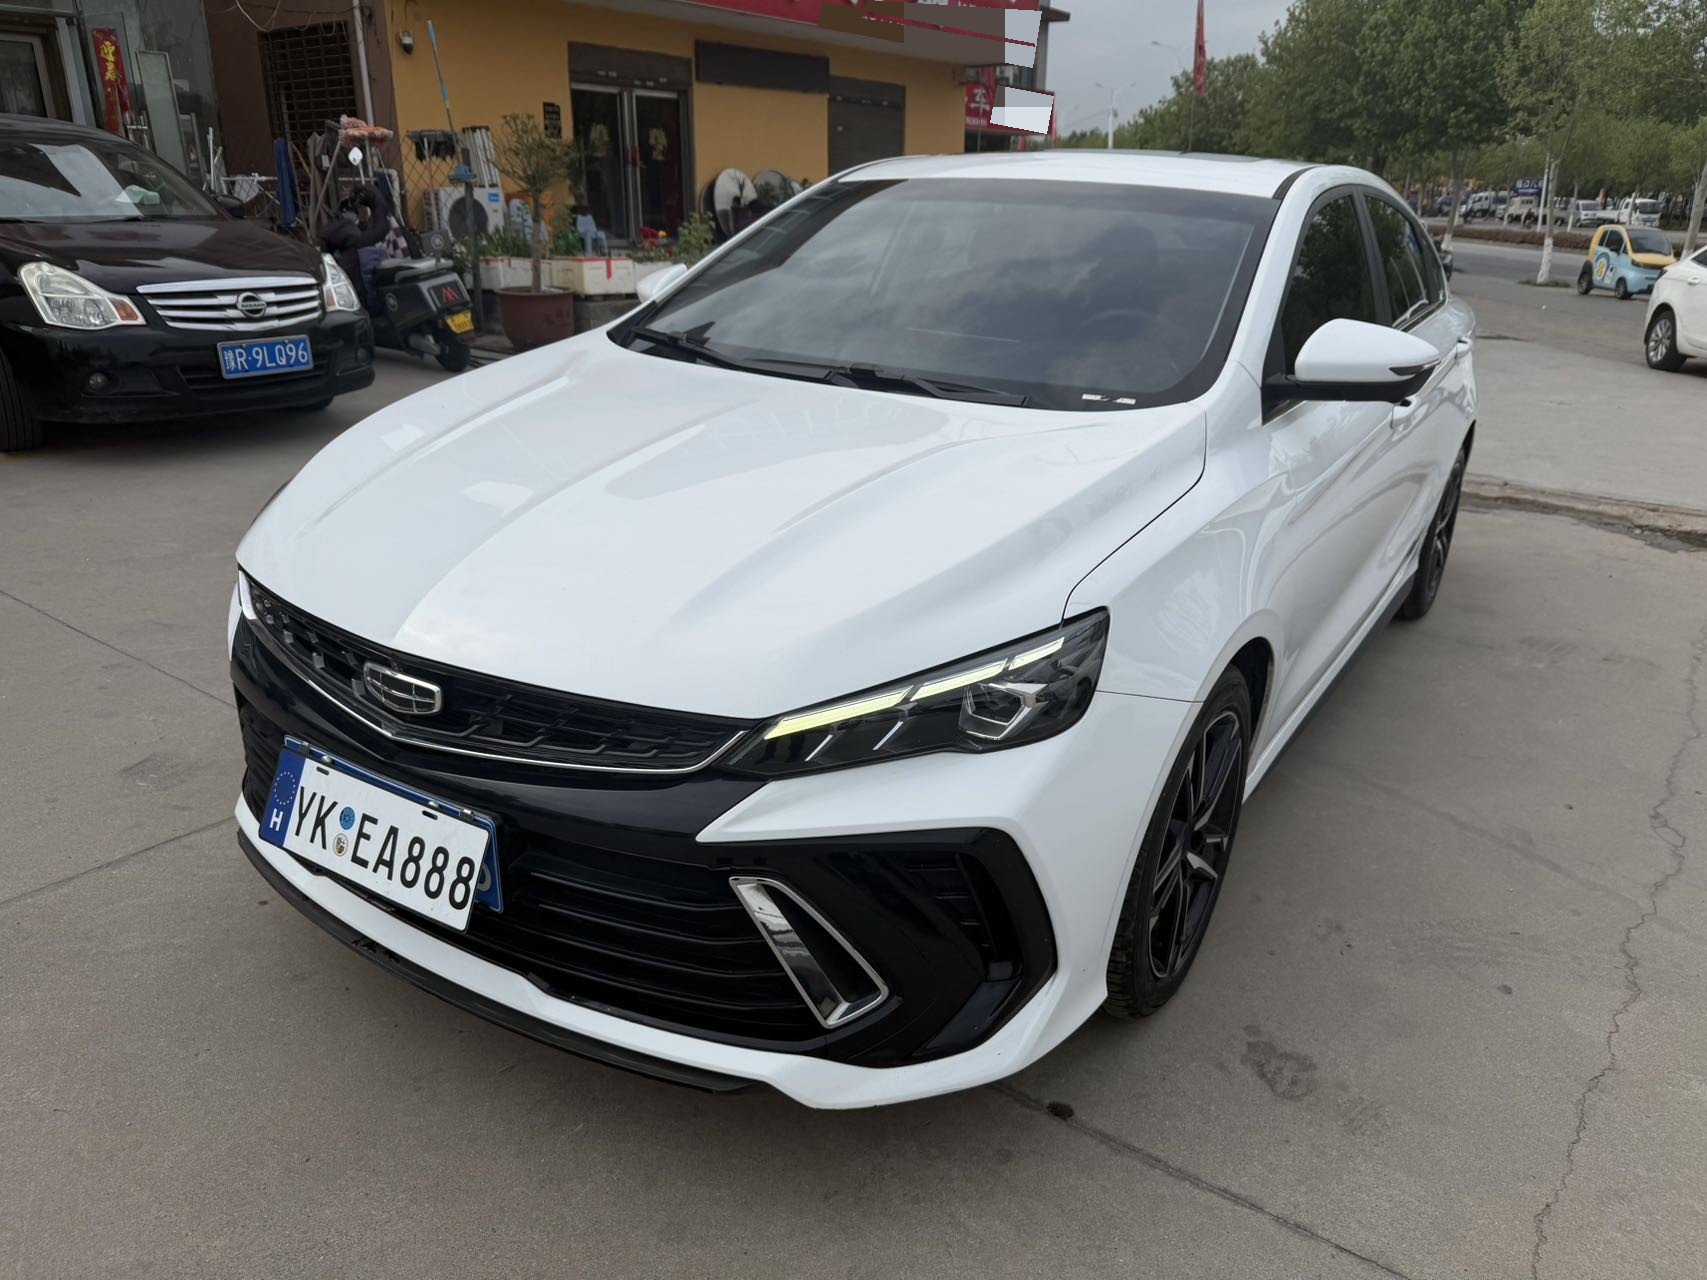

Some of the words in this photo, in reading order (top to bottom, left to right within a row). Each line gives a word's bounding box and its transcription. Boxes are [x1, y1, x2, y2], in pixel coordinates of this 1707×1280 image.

[269, 807, 284, 831] H
[294, 785, 339, 850] YK
[351, 813, 476, 911] EA888
